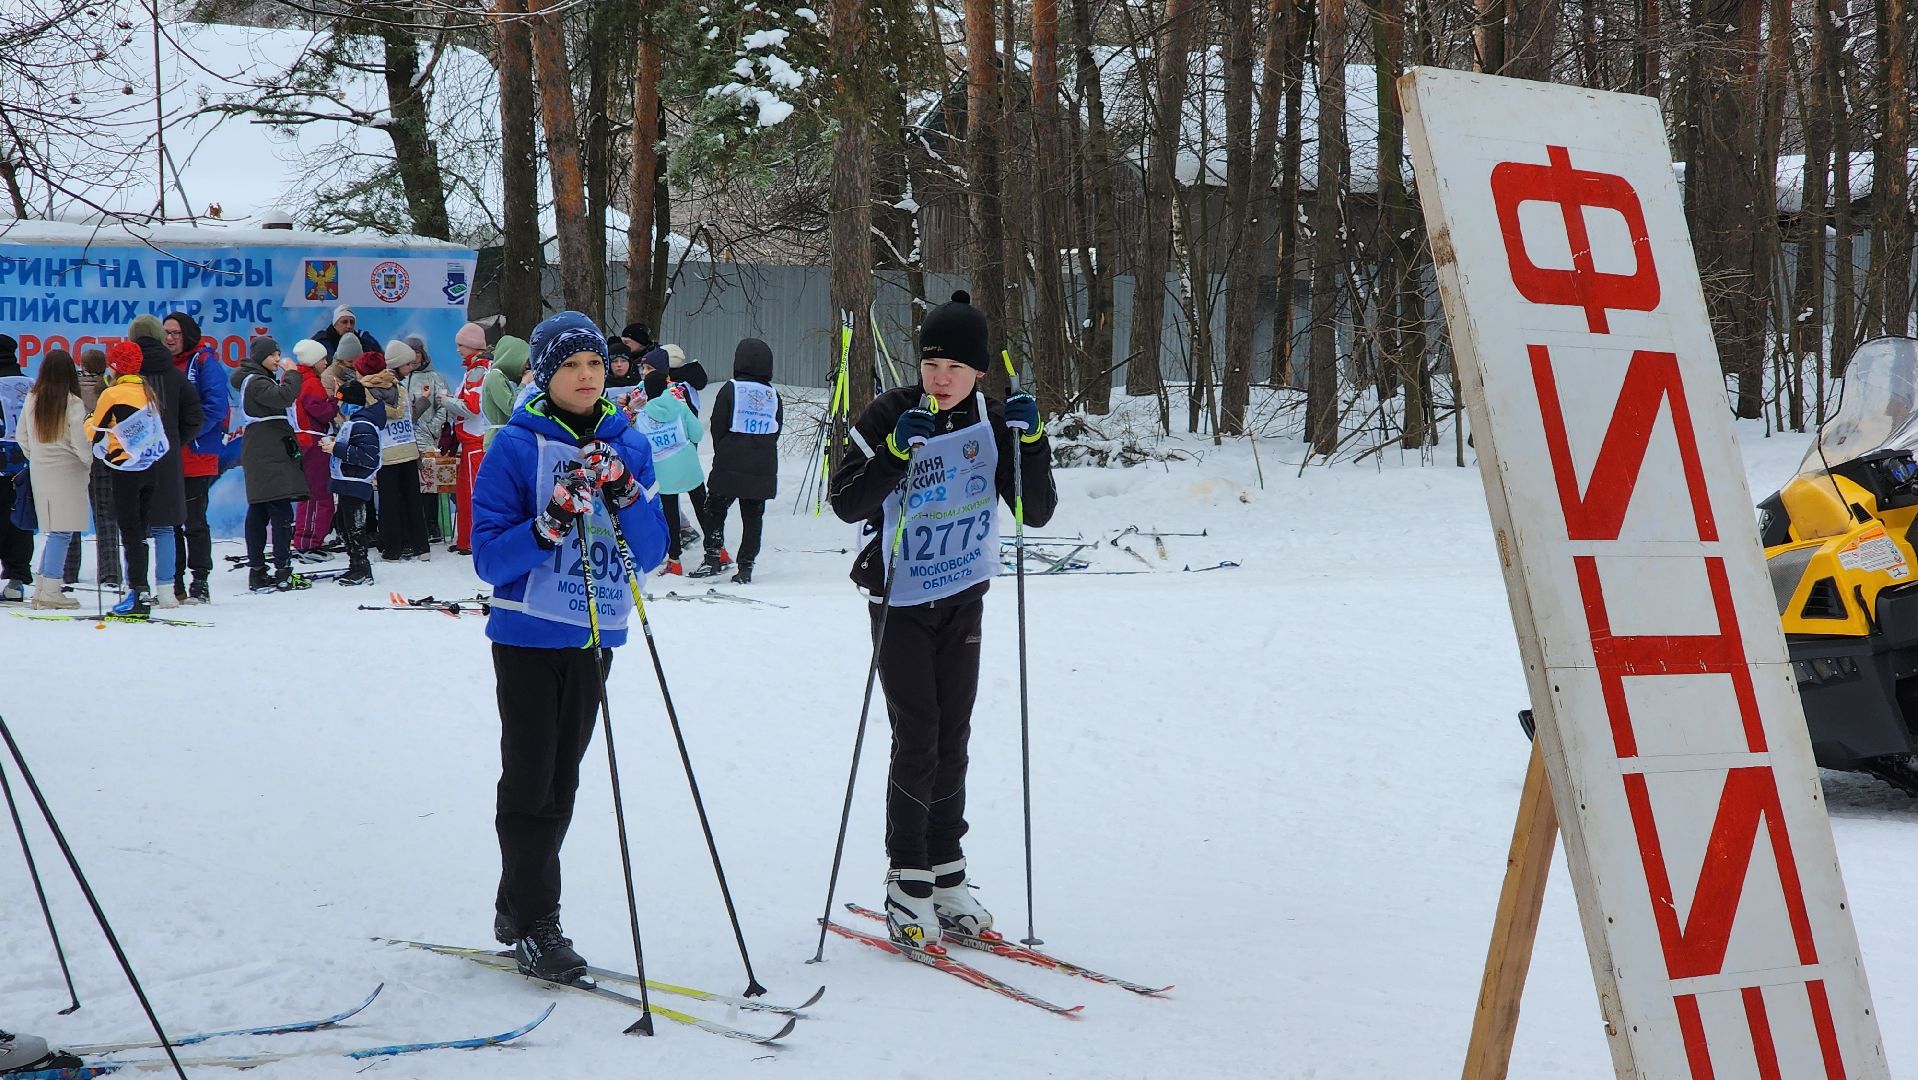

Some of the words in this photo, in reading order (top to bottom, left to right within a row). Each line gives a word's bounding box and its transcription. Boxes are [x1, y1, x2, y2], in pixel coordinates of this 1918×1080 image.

[0, 257, 88, 288] РИНТ
[99, 258, 146, 289] НА
[156, 257, 273, 289] ПРИЗЫ
[213, 298, 273, 324] ЗМС
[744, 418, 770, 434] 1811
[652, 432, 677, 447] 1881
[902, 509, 991, 561] 12773
[910, 547, 982, 577] МОСКОВСКАЯ
[922, 568, 973, 590] ОБЛАСТЬ
[961, 938, 995, 954] ATOMIC
[910, 949, 937, 967] ATOMIC
